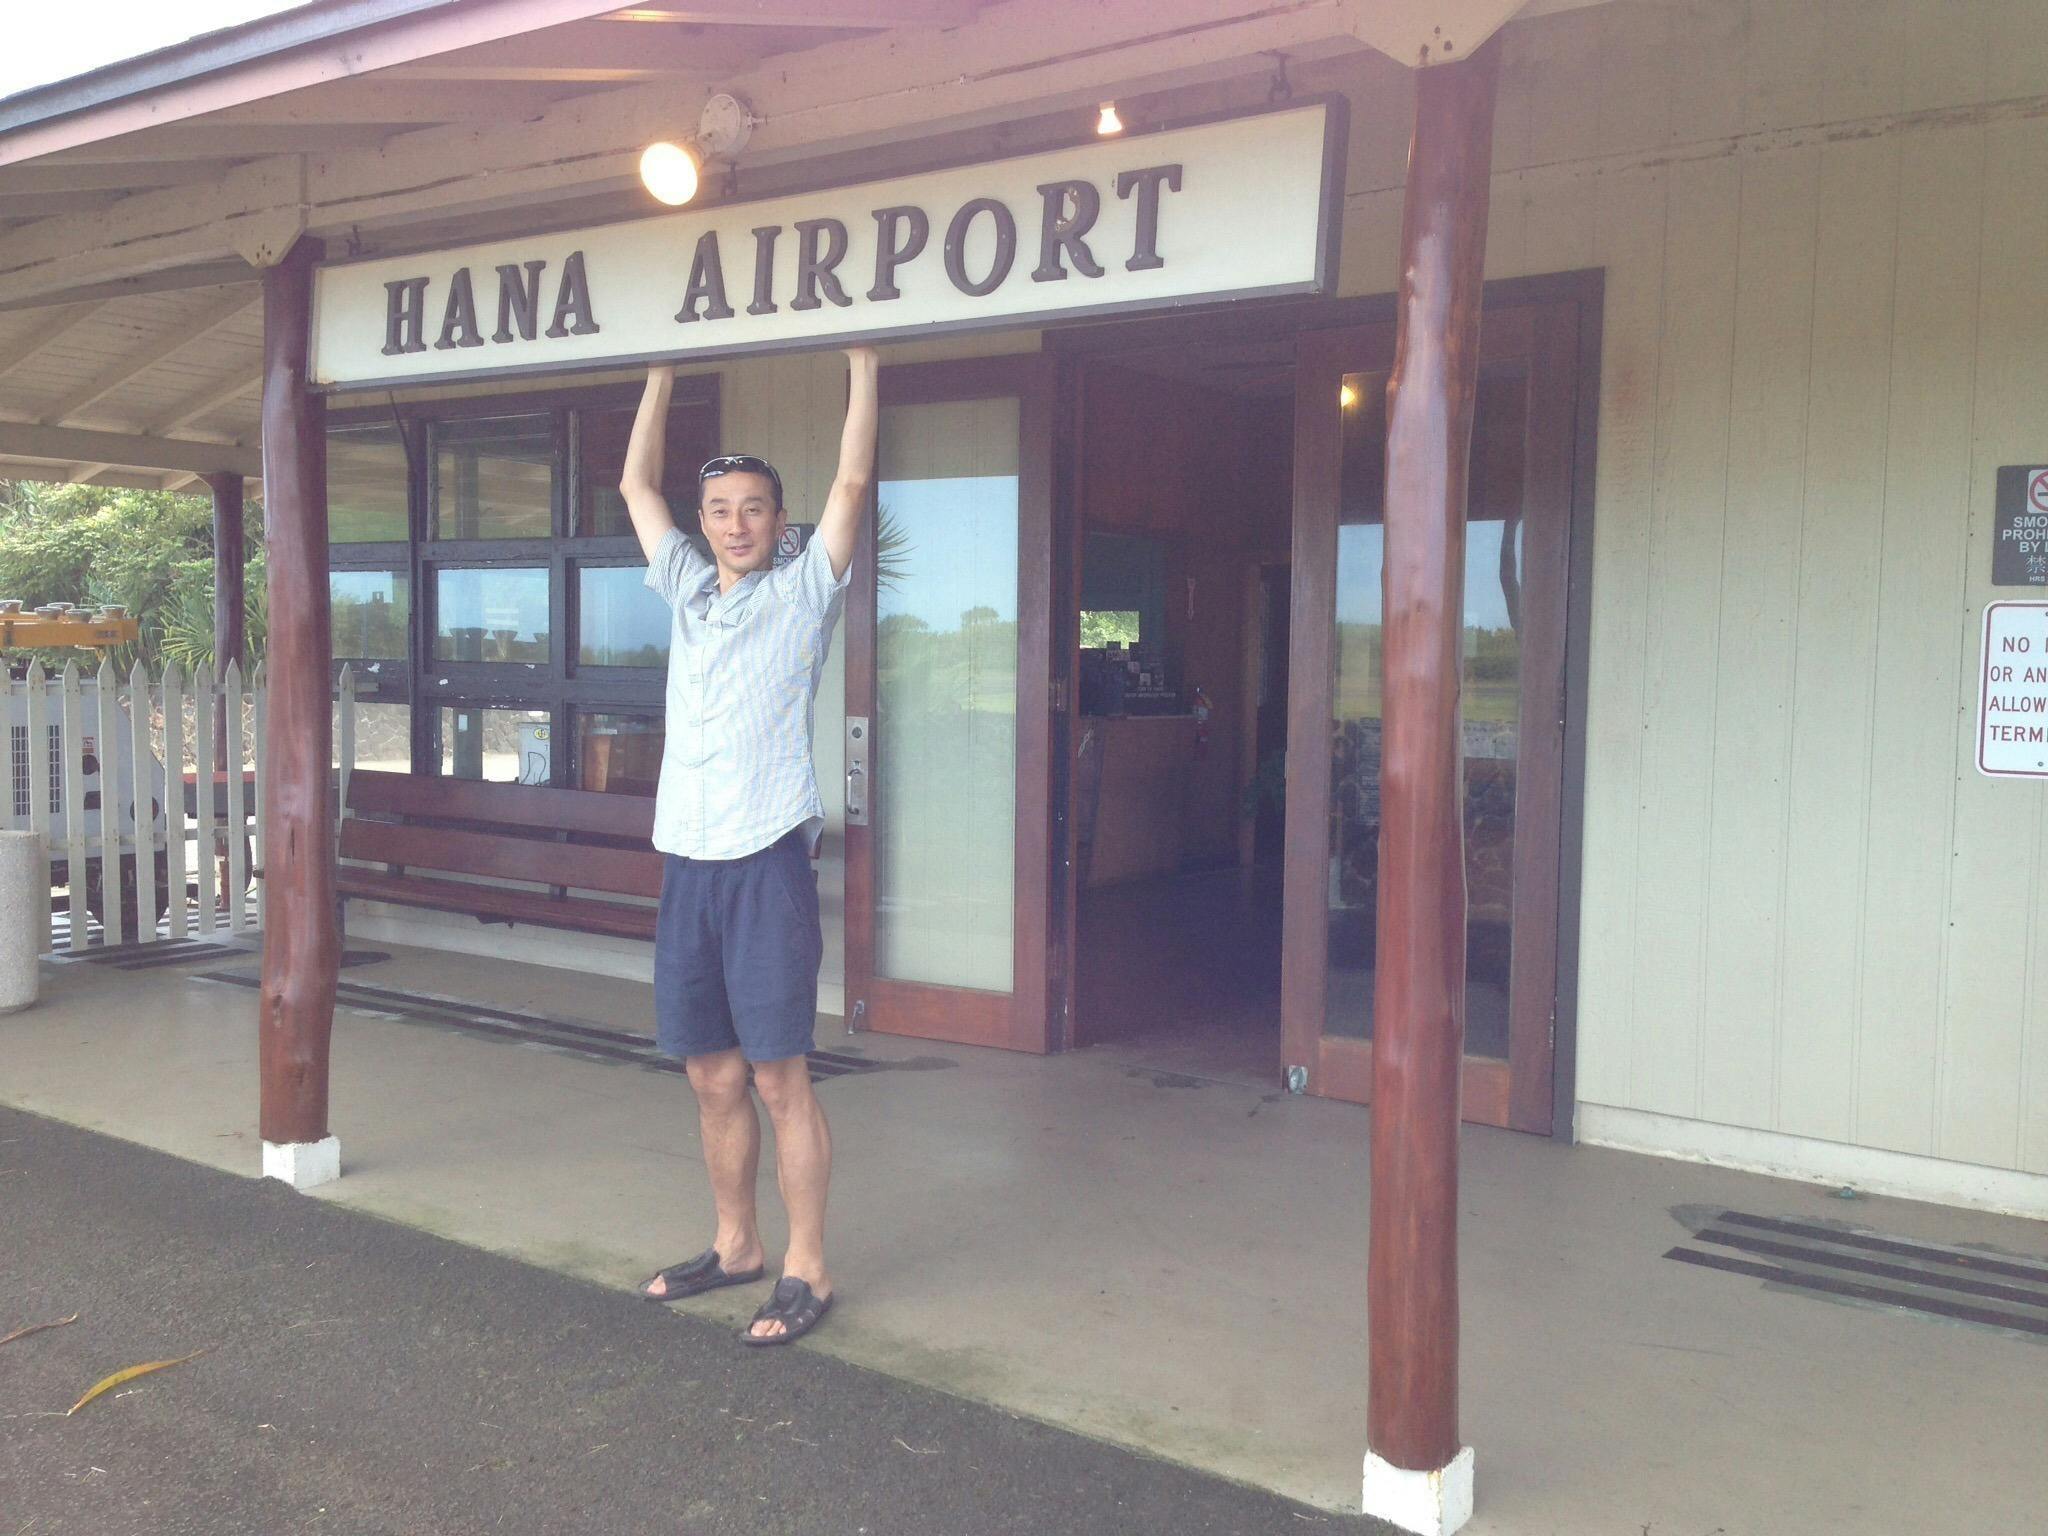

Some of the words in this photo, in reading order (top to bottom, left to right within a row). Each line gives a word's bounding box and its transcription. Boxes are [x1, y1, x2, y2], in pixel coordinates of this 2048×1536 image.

[381, 250, 600, 356] HANA
[674, 163, 1183, 324] AIRPORT
[2019, 541, 2041, 553] BY
[2002, 636, 2030, 653] NO
[1990, 665, 2013, 682] OR
